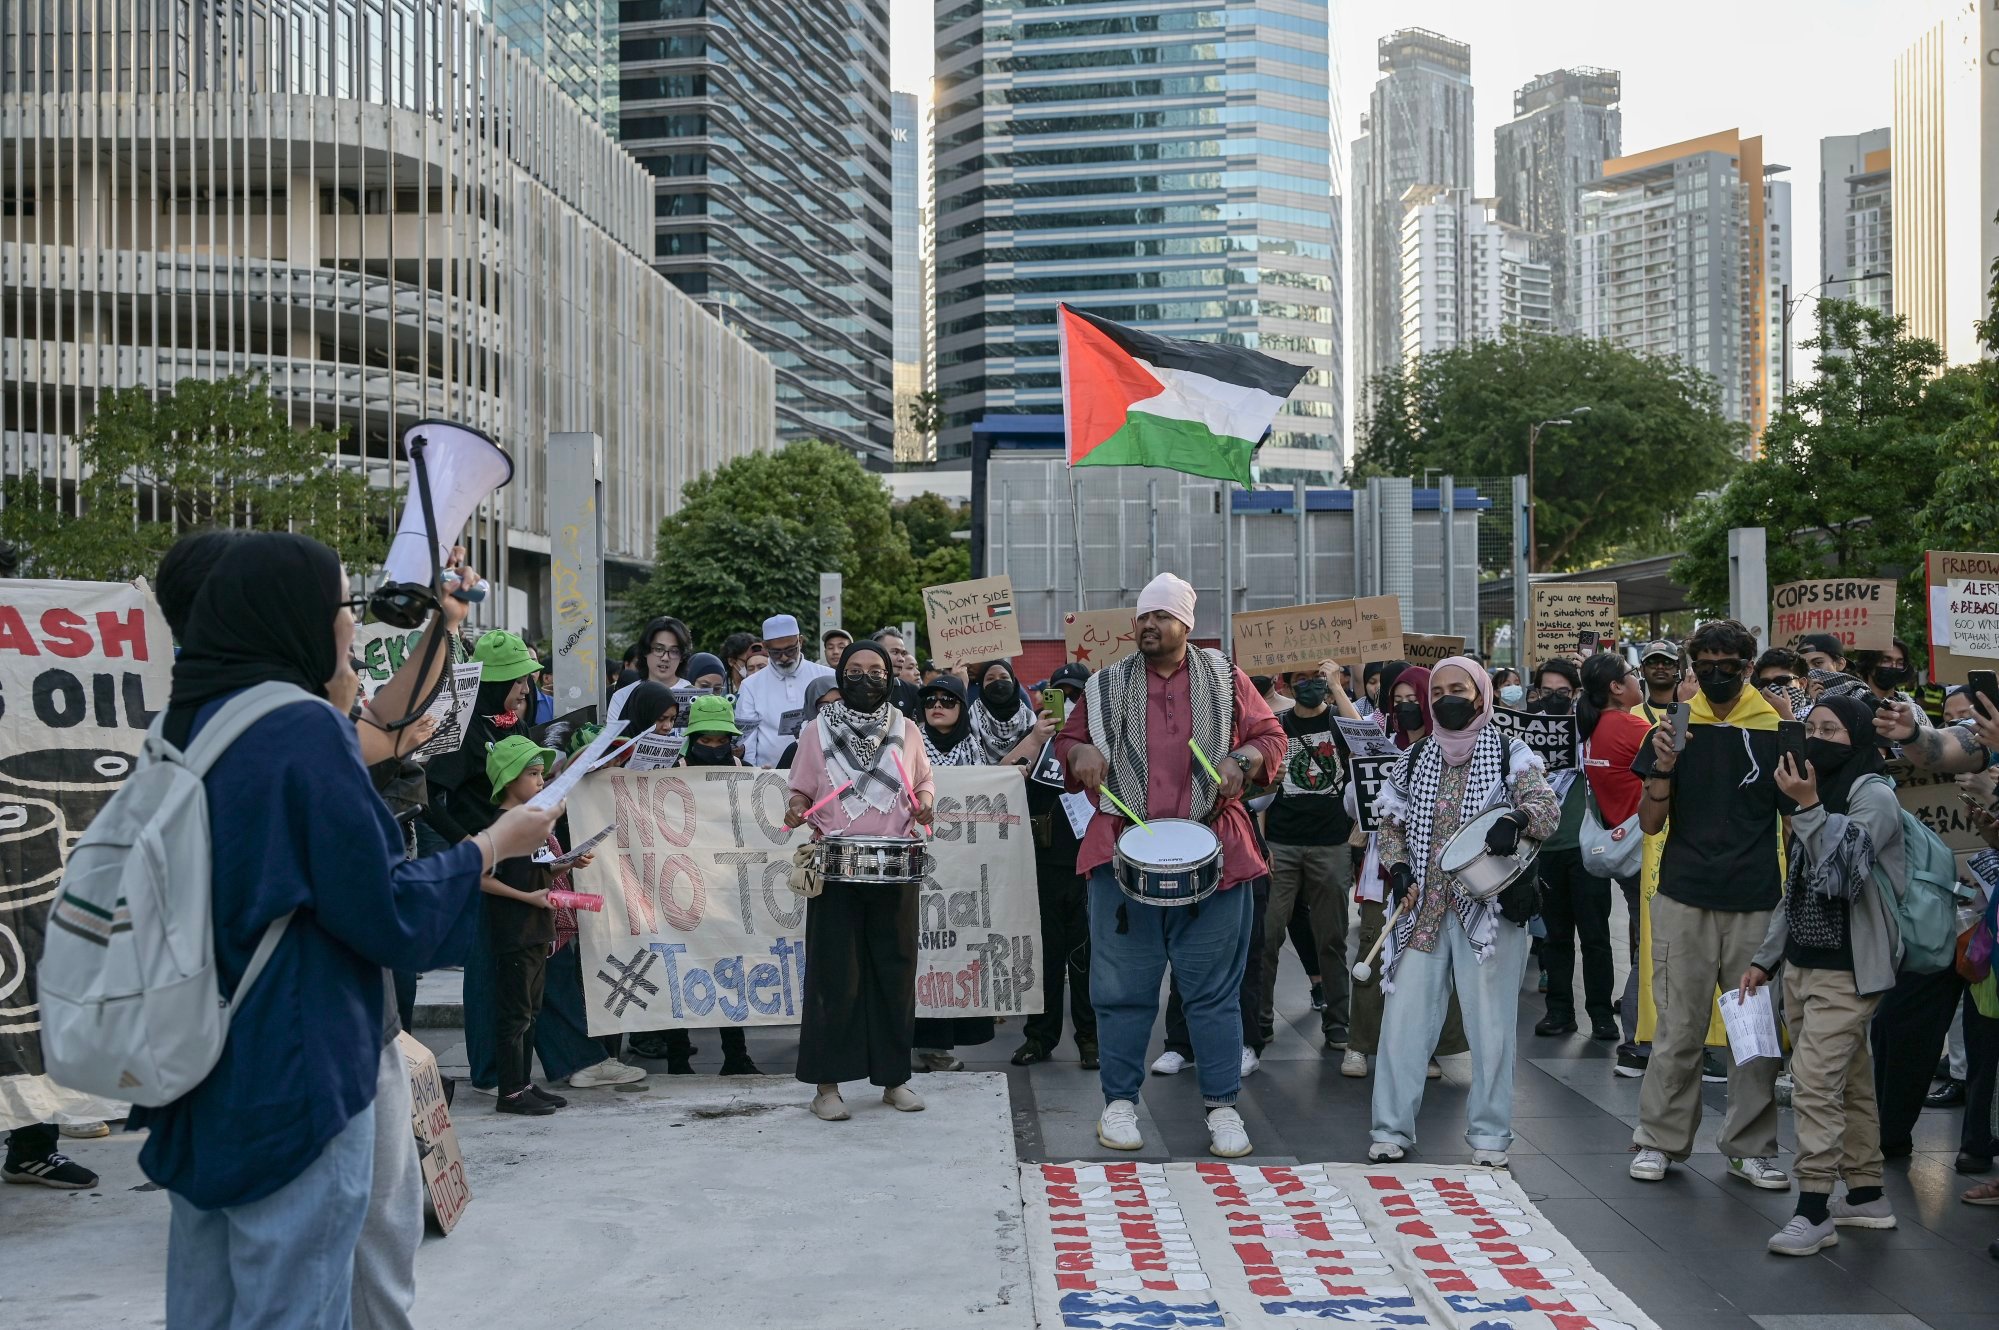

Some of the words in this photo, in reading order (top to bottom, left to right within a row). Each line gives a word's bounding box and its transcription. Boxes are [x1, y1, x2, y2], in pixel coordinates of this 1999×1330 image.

[1525, 74, 1555, 94] STAR
[891, 128, 908, 142] NK
[1942, 557, 1999, 575] PRABOW
[948, 594, 979, 612] DON'T
[983, 589, 1009, 604] SIDE
[1537, 591, 1545, 602] If
[1547, 595, 1563, 607] you
[1567, 595, 1582, 604] are
[1586, 594, 1615, 605] neutral
[1776, 584, 1819, 609] COPS
[1823, 582, 1881, 602] SERVE
[947, 612, 980, 626] WITH
[1554, 608, 1595, 617] situations
[1599, 607, 1609, 617] of
[1777, 607, 1868, 634] TRUMP!!!!
[0, 605, 149, 662] ASH
[940, 619, 1007, 642] GENOCIDE.
[1239, 620, 1276, 639] WTF
[1285, 623, 1294, 635] is
[1299, 617, 1327, 631] USA
[1331, 616, 1353, 630] doing
[1361, 611, 1379, 622] here
[1577, 622, 1591, 630] you
[1595, 620, 1615, 628] have
[1603, 630, 1613, 638] of
[1954, 619, 1975, 629] 600
[1264, 640, 1273, 649] in
[1403, 643, 1457, 659] ENOCIDE
[1537, 642, 1549, 650] the
[1554, 643, 1578, 652] oppre
[32, 667, 161, 730] OIL
[1492, 712, 1569, 734] OLAK
[637, 744, 661, 757] BANTAH
[610, 774, 697, 849] NO
[705, 771, 794, 848] TO
[618, 852, 707, 936] NO
[713, 851, 805, 935] TO
[920, 863, 992, 931] nal
[596, 936, 806, 1023] #Toget
[915, 959, 981, 1010] ainst
[430, 1160, 469, 1228] HITLER
